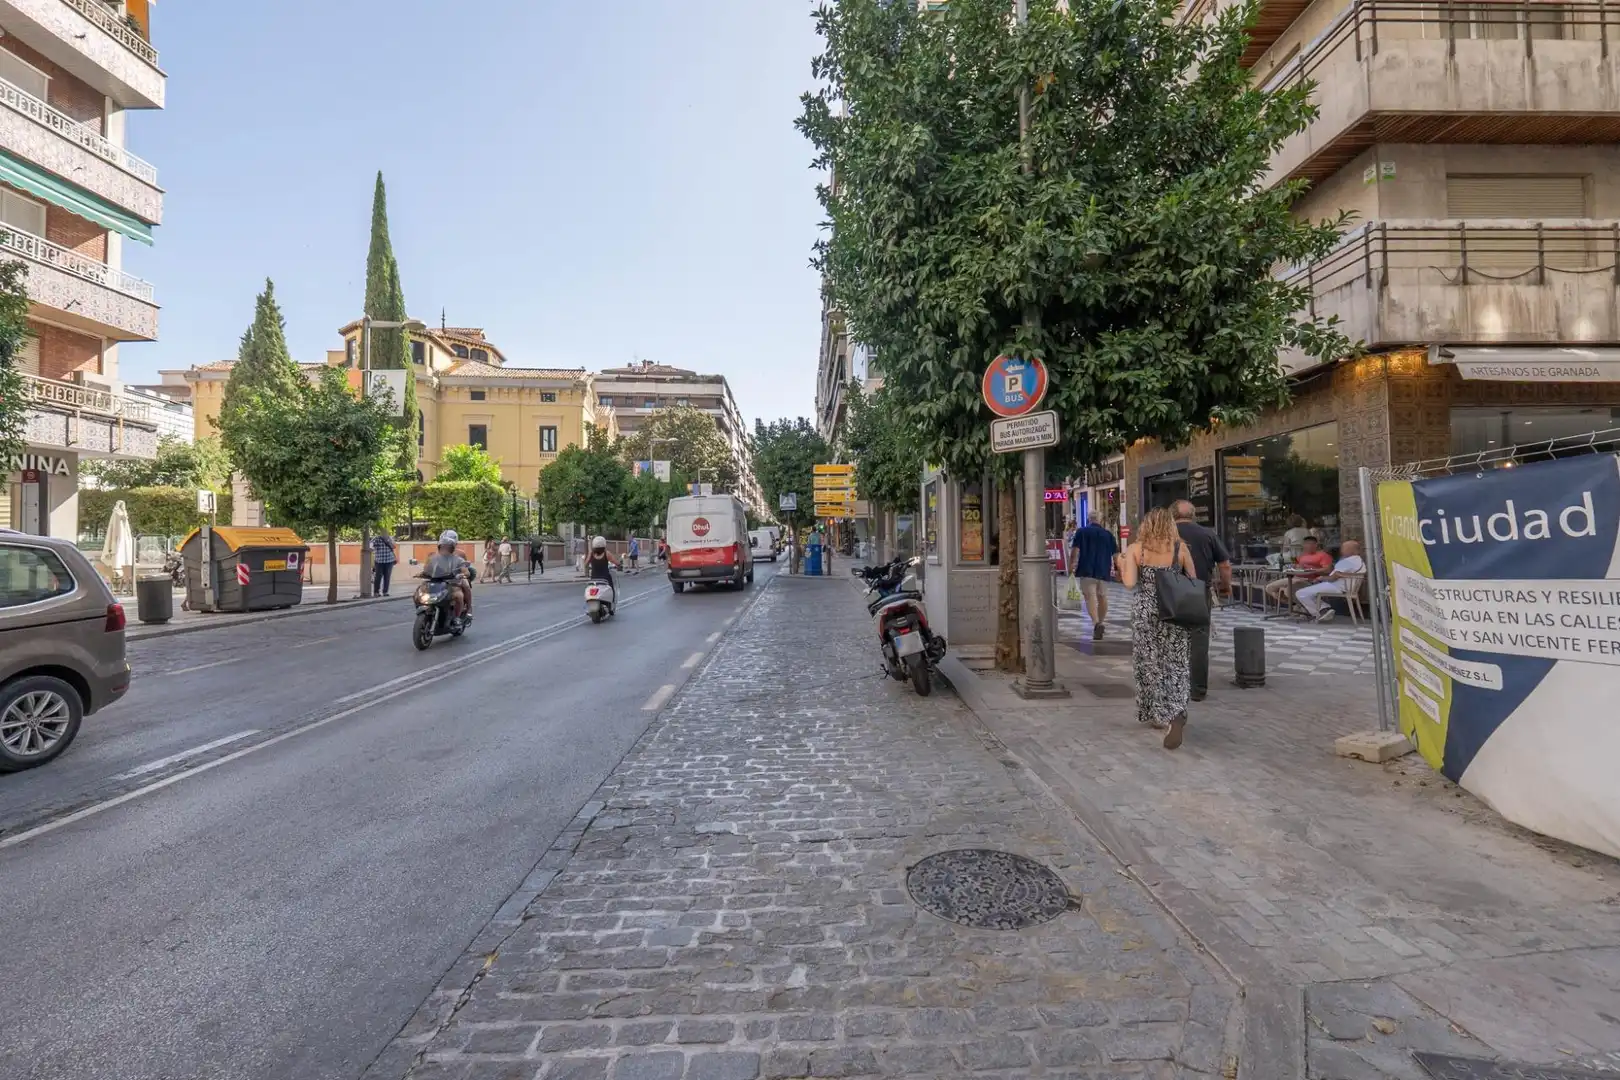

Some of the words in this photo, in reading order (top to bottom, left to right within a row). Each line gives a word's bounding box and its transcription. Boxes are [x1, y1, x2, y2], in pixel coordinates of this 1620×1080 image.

[1470, 367, 1529, 377] ARTESANOS
[1532, 367, 1546, 377] DE
[1548, 367, 1600, 377] GRANADA
[1008, 377, 1019, 390] P
[1004, 393, 1024, 402] BUS
[1006, 418, 1039, 429] PERMITIDO
[1000, 430, 1011, 438] BUS
[1012, 425, 1047, 437] AUTORIZADO
[1419, 491, 1597, 546] ciudad
[1425, 583, 1537, 604] ESTRUCTURAS
[1540, 590, 1552, 604] Y
[1451, 610, 1493, 624] AGUA
[1499, 611, 1519, 625] EN
[1525, 613, 1555, 627] LAS
[1560, 614, 1620, 631] CALLE
[1459, 629, 1469, 641] Y
[1473, 630, 1504, 645] SAN
[1508, 634, 1581, 652] VICENTE
[1587, 639, 1620, 655] FER
[1473, 671, 1493, 683] S.L.
